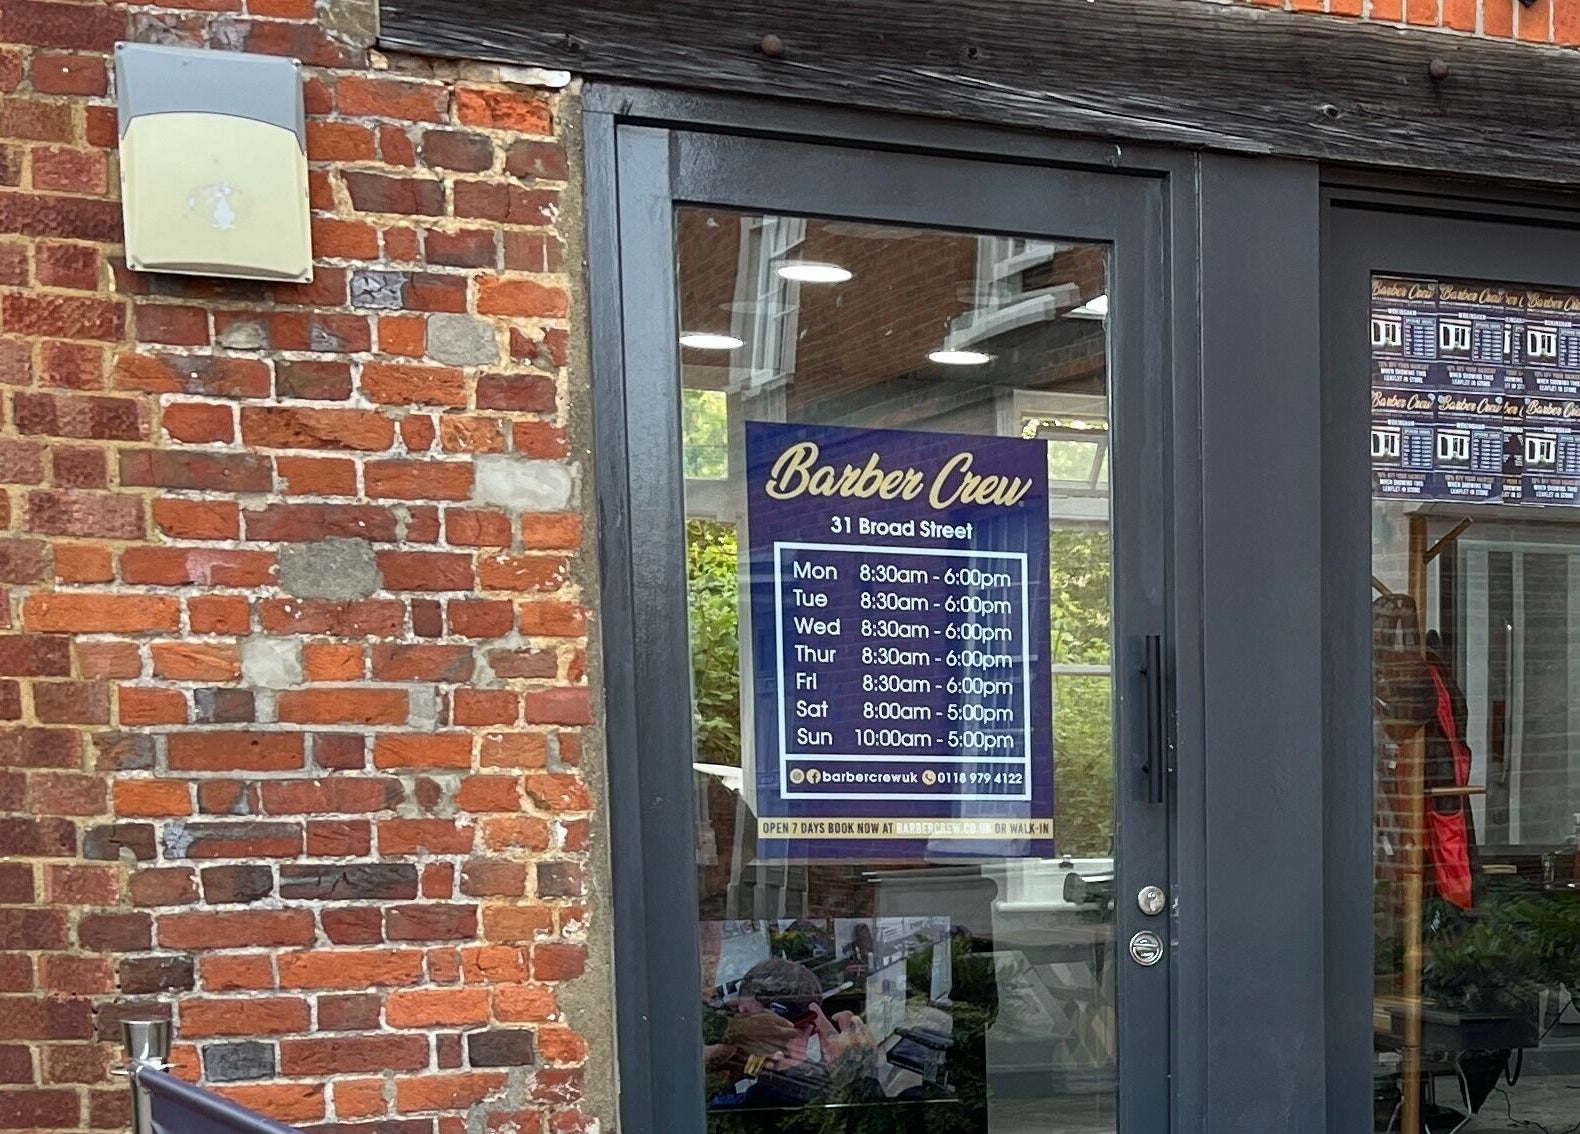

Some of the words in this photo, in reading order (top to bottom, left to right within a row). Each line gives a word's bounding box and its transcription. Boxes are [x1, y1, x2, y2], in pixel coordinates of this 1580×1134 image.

[765, 442, 924, 500] Barber
[928, 452, 1032, 509] Crew
[830, 516, 851, 534] 31
[859, 517, 914, 537] Broad
[920, 520, 973, 540] Street
[793, 561, 838, 580] Mon
[860, 564, 928, 584] 8:30am
[944, 568, 1012, 590] 6:00pm
[792, 589, 828, 608] Tue
[860, 591, 929, 611] 8:30am
[944, 596, 1012, 617] 6:00pm
[793, 616, 841, 636] Wed
[860, 619, 930, 638] 8:30am
[945, 622, 1013, 644] 6:00pm
[794, 645, 837, 663] Thur
[861, 647, 930, 666] 8:30am
[946, 650, 1013, 670] 6:00pm
[796, 672, 818, 690] Fri
[862, 674, 931, 693] 8:30am
[946, 677, 1014, 698] 6:00pm
[796, 700, 828, 718] Sat
[863, 702, 931, 720] 8:00am
[947, 704, 1014, 724] 5:00pm
[797, 728, 833, 746] Sun
[855, 729, 932, 748] 10:00am
[948, 731, 1014, 752] 5:00pm
[822, 770, 918, 784] barbercrewuk
[938, 772, 966, 784] 0118
[969, 772, 991, 784] 979
[994, 772, 1023, 784] 4122
[763, 823, 788, 834] OPEN
[792, 823, 798, 834] 7
[801, 823, 825, 834] DAYS
[828, 823, 854, 834] BOOK
[858, 823, 879, 834] NOW
[882, 823, 894, 834] AT
[994, 823, 1007, 834] OR
[1010, 823, 1049, 834] WALK-IN
